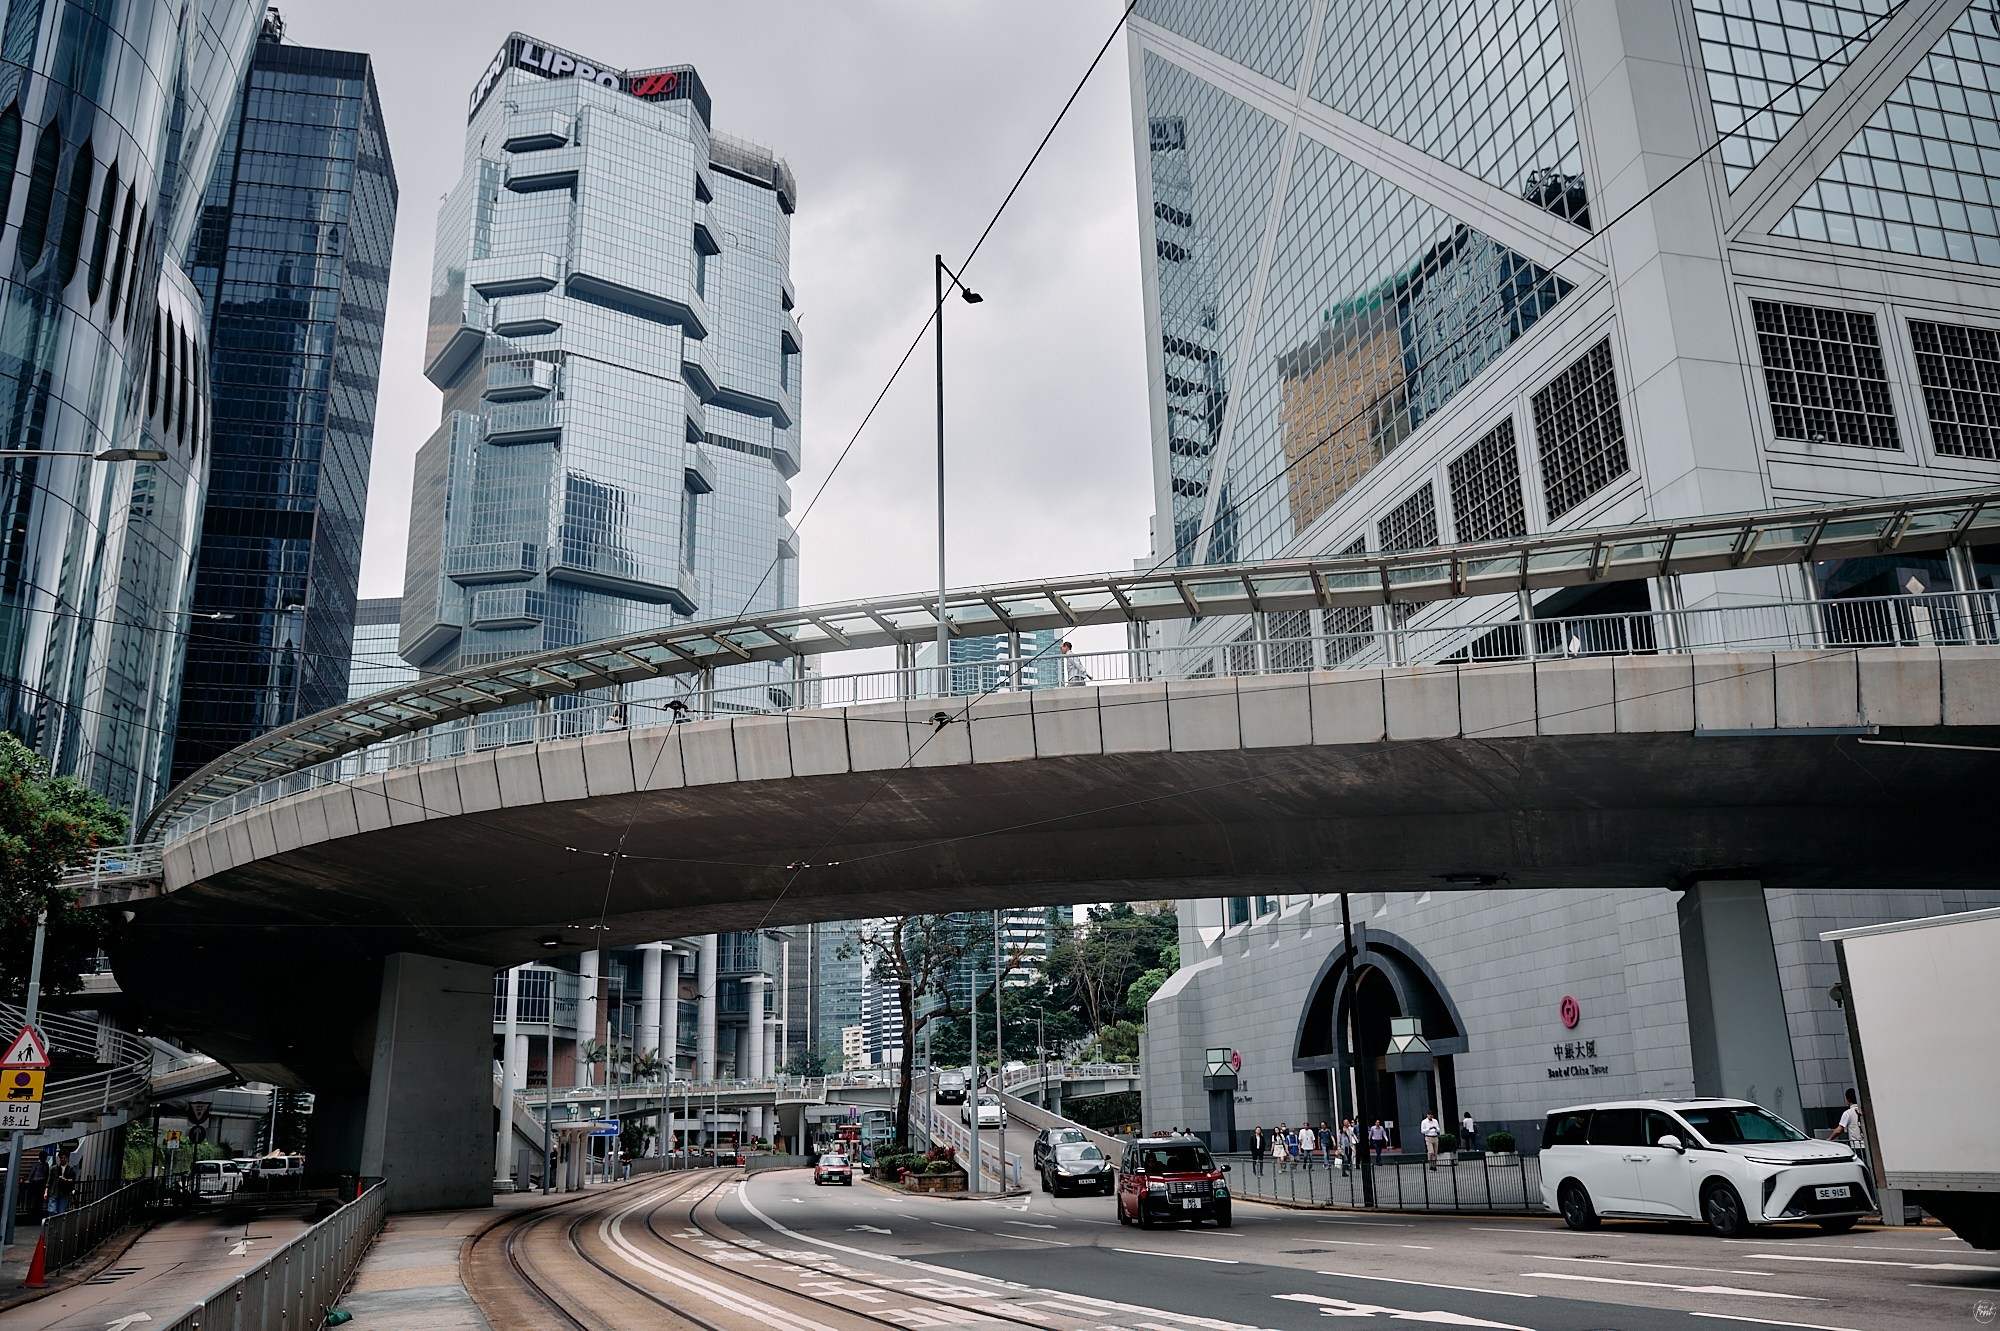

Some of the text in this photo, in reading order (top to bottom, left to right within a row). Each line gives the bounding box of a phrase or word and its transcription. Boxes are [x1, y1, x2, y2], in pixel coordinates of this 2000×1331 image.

[520, 42, 620, 91] LIPPO
[470, 48, 506, 115] LIPPO
[1547, 1066, 1564, 1079] Bank
[1570, 1065, 1589, 1077] China
[1589, 1064, 1609, 1075] Tower
[8, 1104, 30, 1113] End
[1, 1115, 31, 1127] 終止
[1819, 1188, 1847, 1198] SE 9151
[867, 1300, 1112, 1328] LANE
